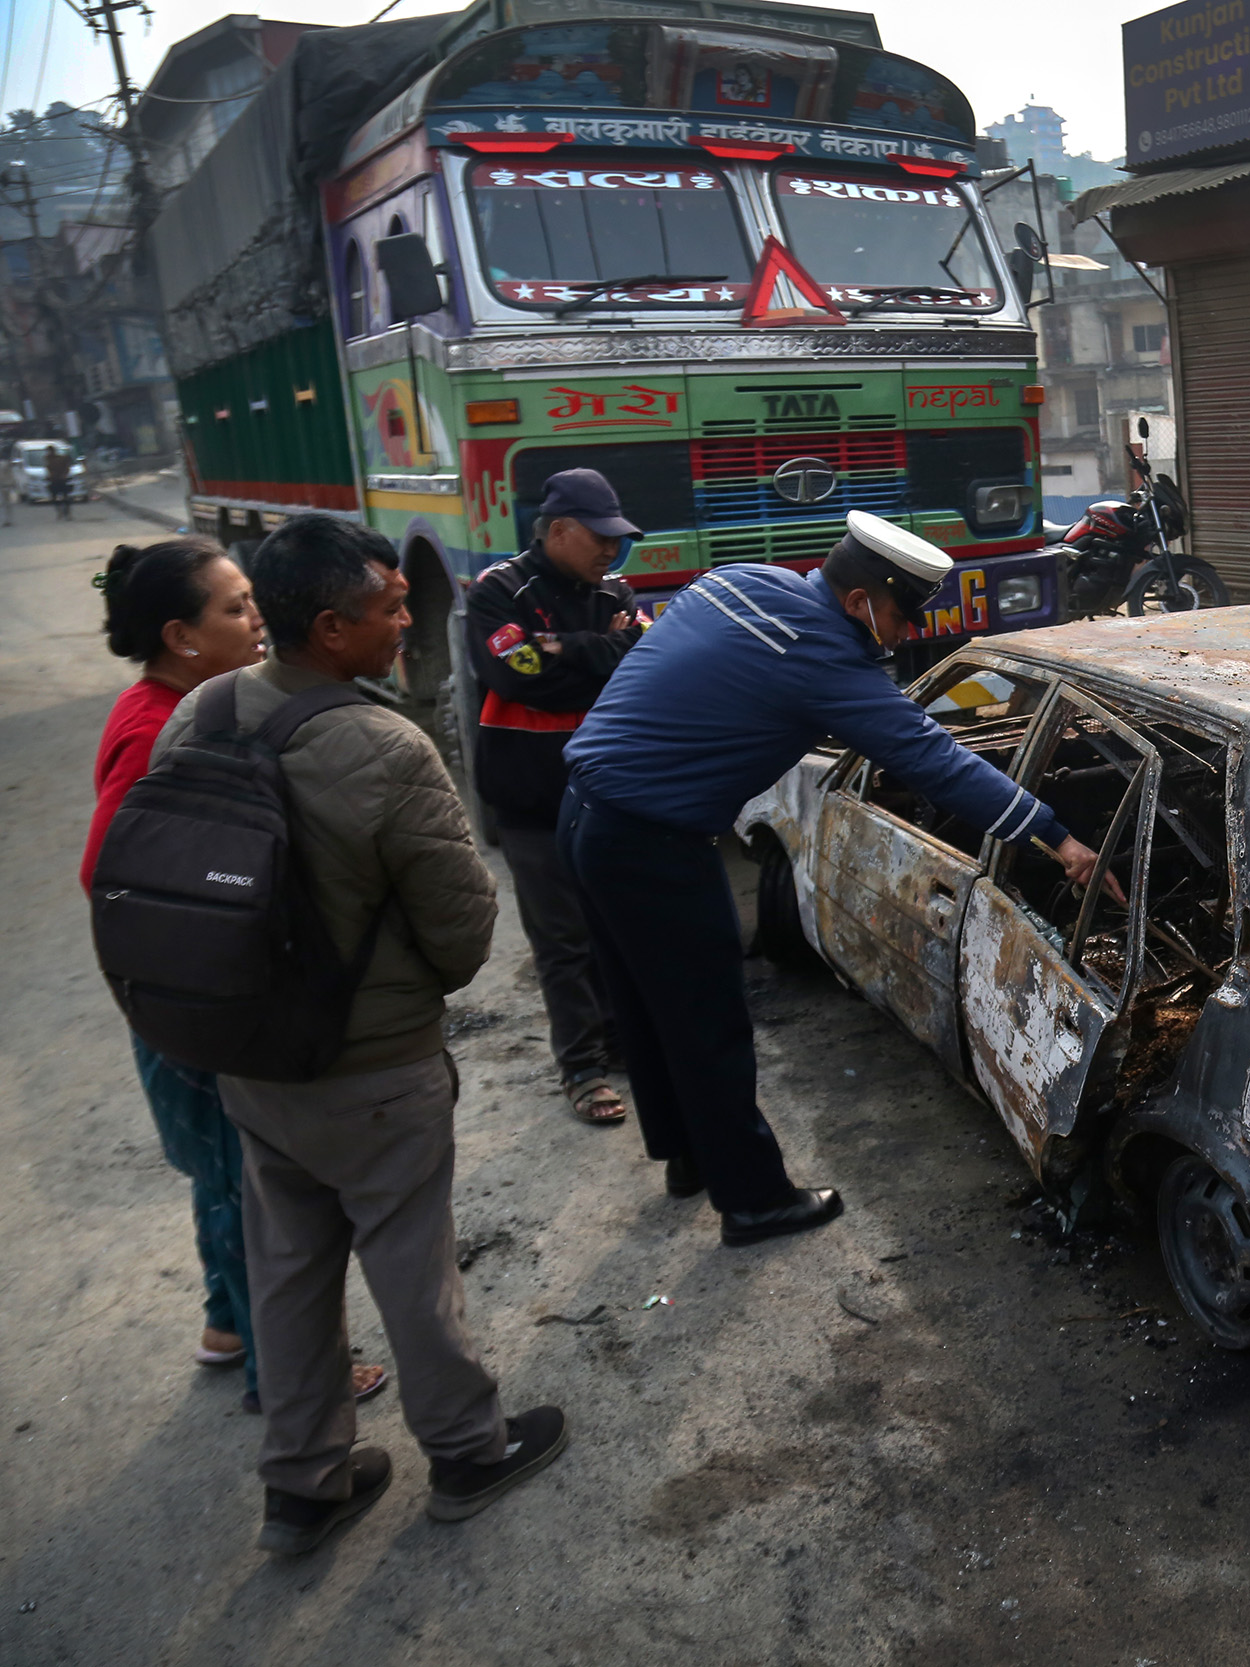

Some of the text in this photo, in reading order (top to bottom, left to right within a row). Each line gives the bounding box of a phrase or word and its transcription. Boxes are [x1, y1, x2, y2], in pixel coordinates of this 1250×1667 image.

[1160, 0, 1245, 44] Kunjan
[1164, 67, 1243, 113] Pvt Ltd
[543, 117, 692, 146] बालकुमारी
[523, 169, 684, 188] सत्य
[545, 385, 685, 419] मेरो
[761, 394, 842, 417] TATA
[205, 869, 256, 888] BACKPACK
